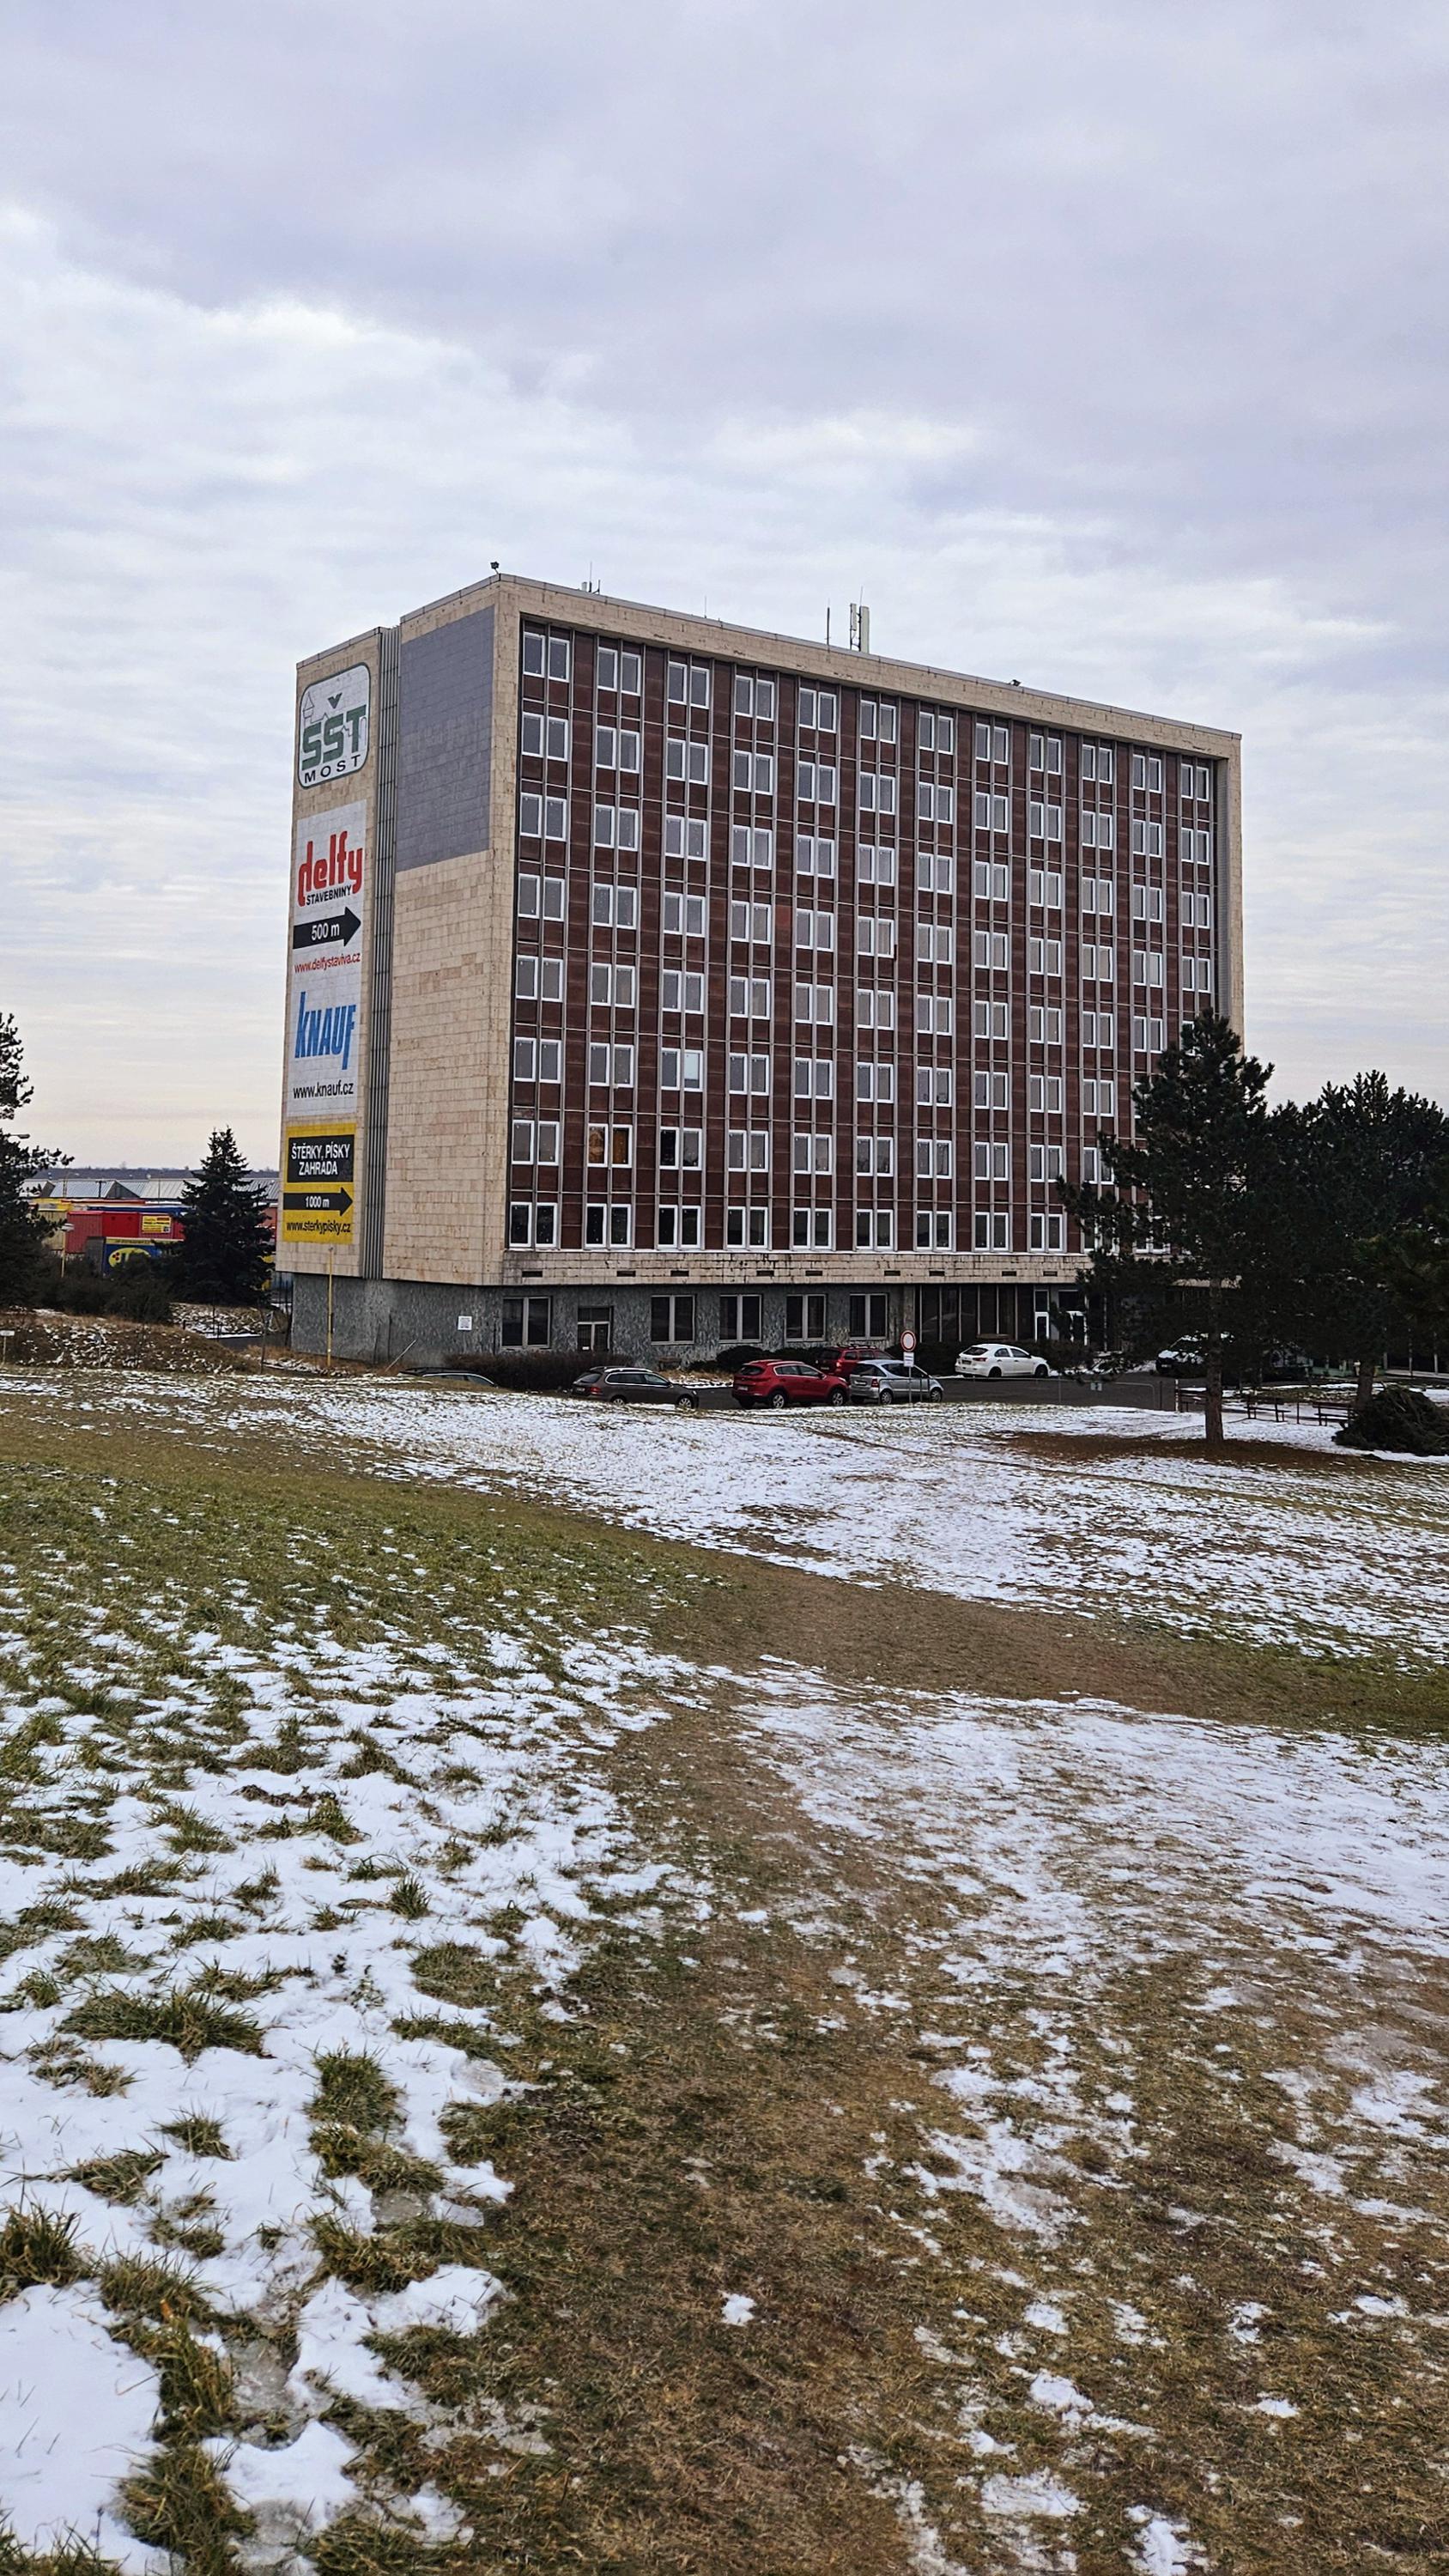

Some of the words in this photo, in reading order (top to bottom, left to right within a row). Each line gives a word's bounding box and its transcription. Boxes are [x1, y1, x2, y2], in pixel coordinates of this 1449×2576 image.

[304, 754, 361, 784] MOST
[298, 830, 362, 907] delfy
[306, 885, 352, 906] STAVEBNINY
[311, 922, 329, 941] 500
[330, 923, 340, 937] m
[294, 952, 361, 973] www.delfystaviva.cz
[293, 1080, 354, 1099] www.knauf.cz
[291, 1143, 324, 1161] ŠTĚRKY,
[324, 1141, 350, 1159] PÍSKY
[298, 1160, 338, 1176] ZAHRADA
[322, 1199, 330, 1208] m
[287, 1219, 351, 1235] www.sterkypisky.cz
